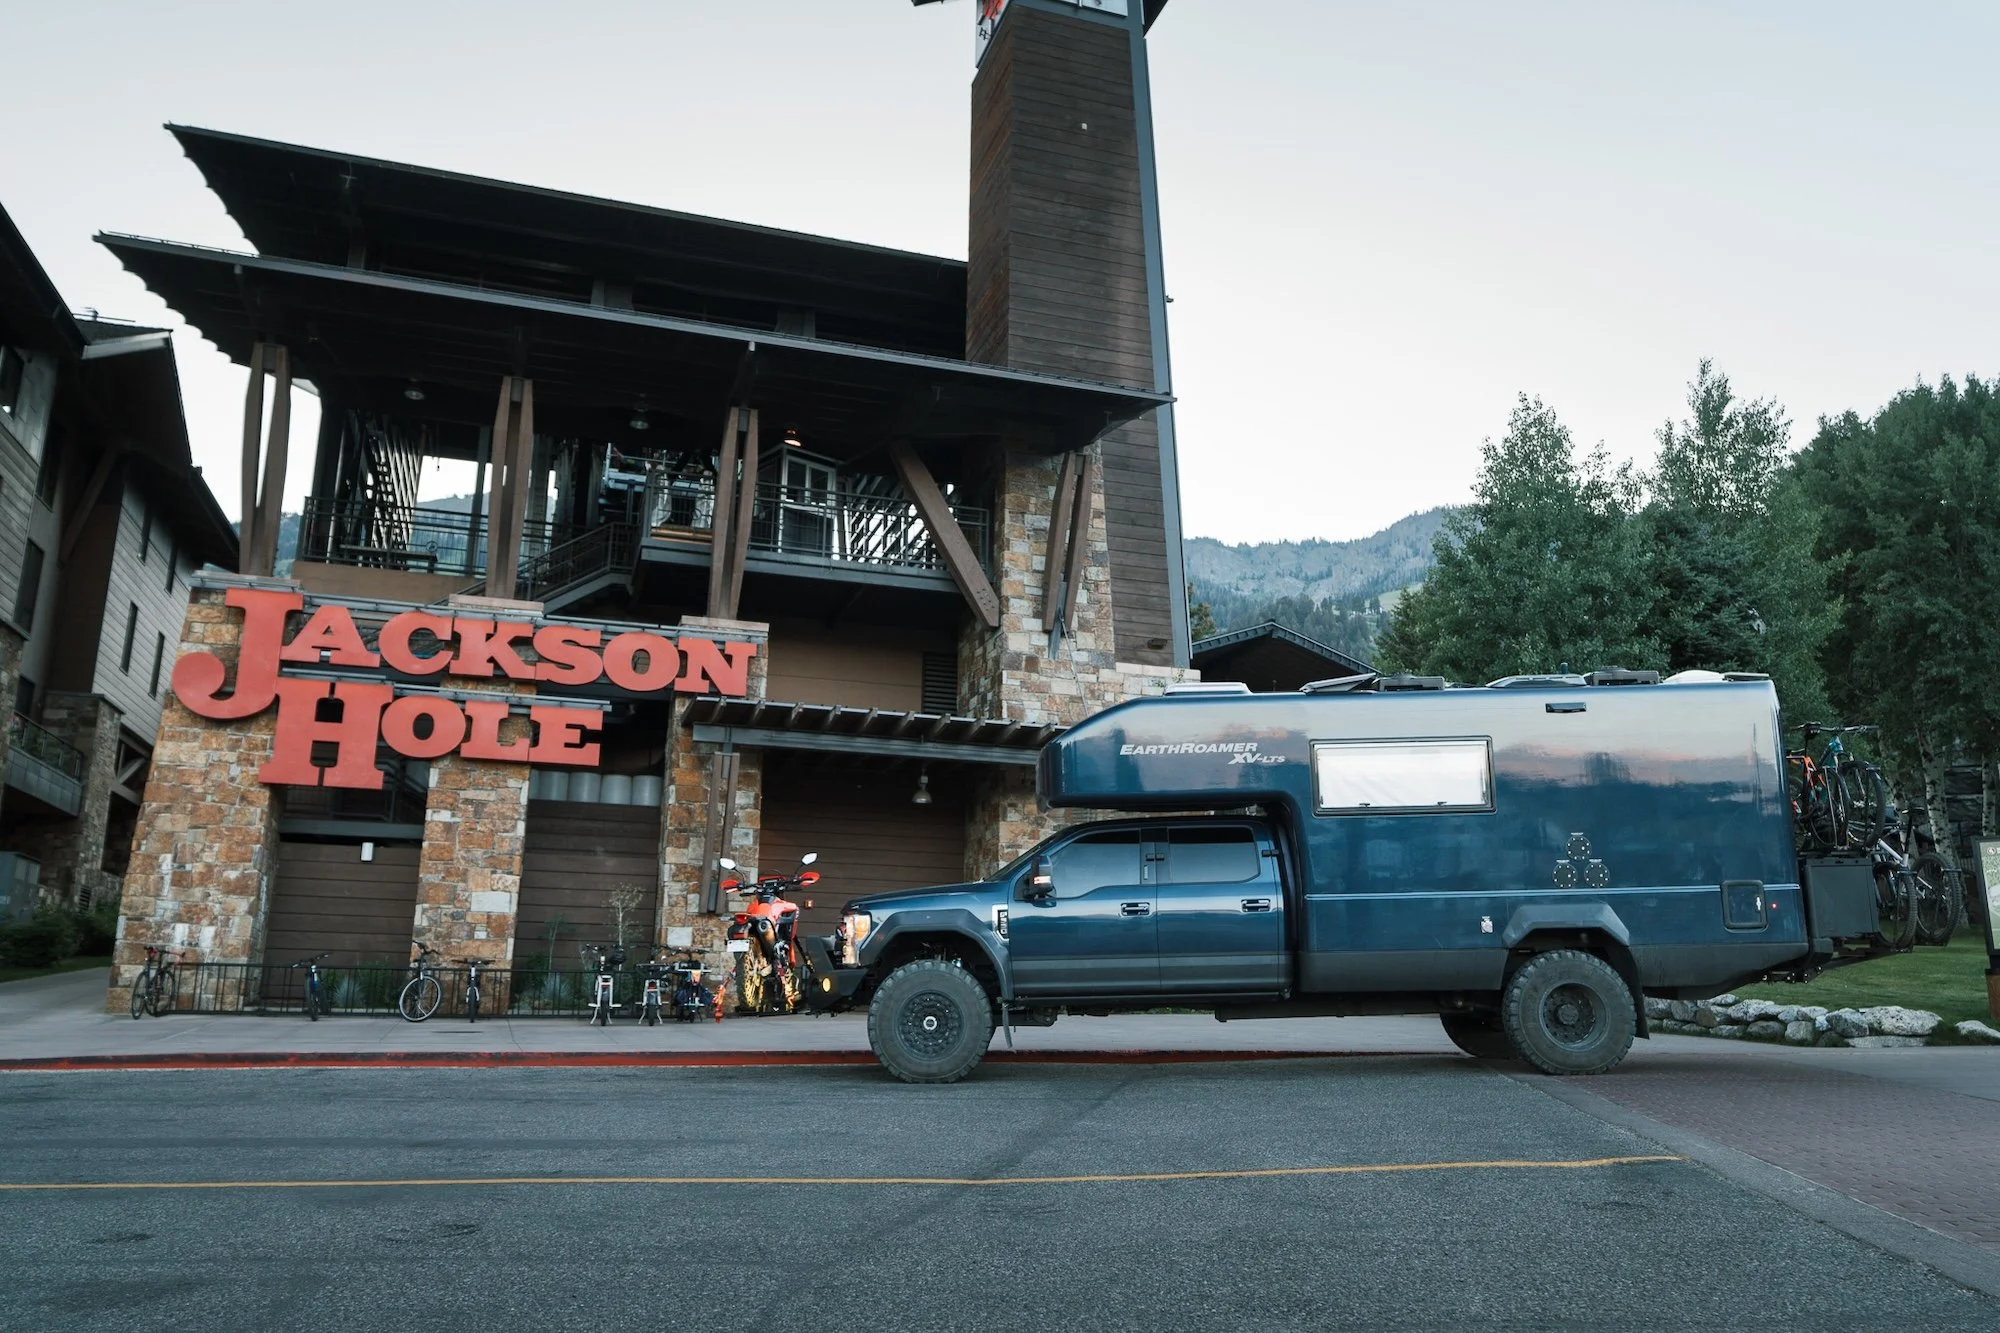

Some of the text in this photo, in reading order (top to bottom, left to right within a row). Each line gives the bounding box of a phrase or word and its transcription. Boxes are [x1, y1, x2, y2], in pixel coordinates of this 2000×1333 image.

[172, 588, 757, 719] JACKSON
[258, 678, 603, 790] HOLE
[1119, 742, 1258, 756] EARTHROAMER
[1227, 752, 1286, 765] XV-LTS
